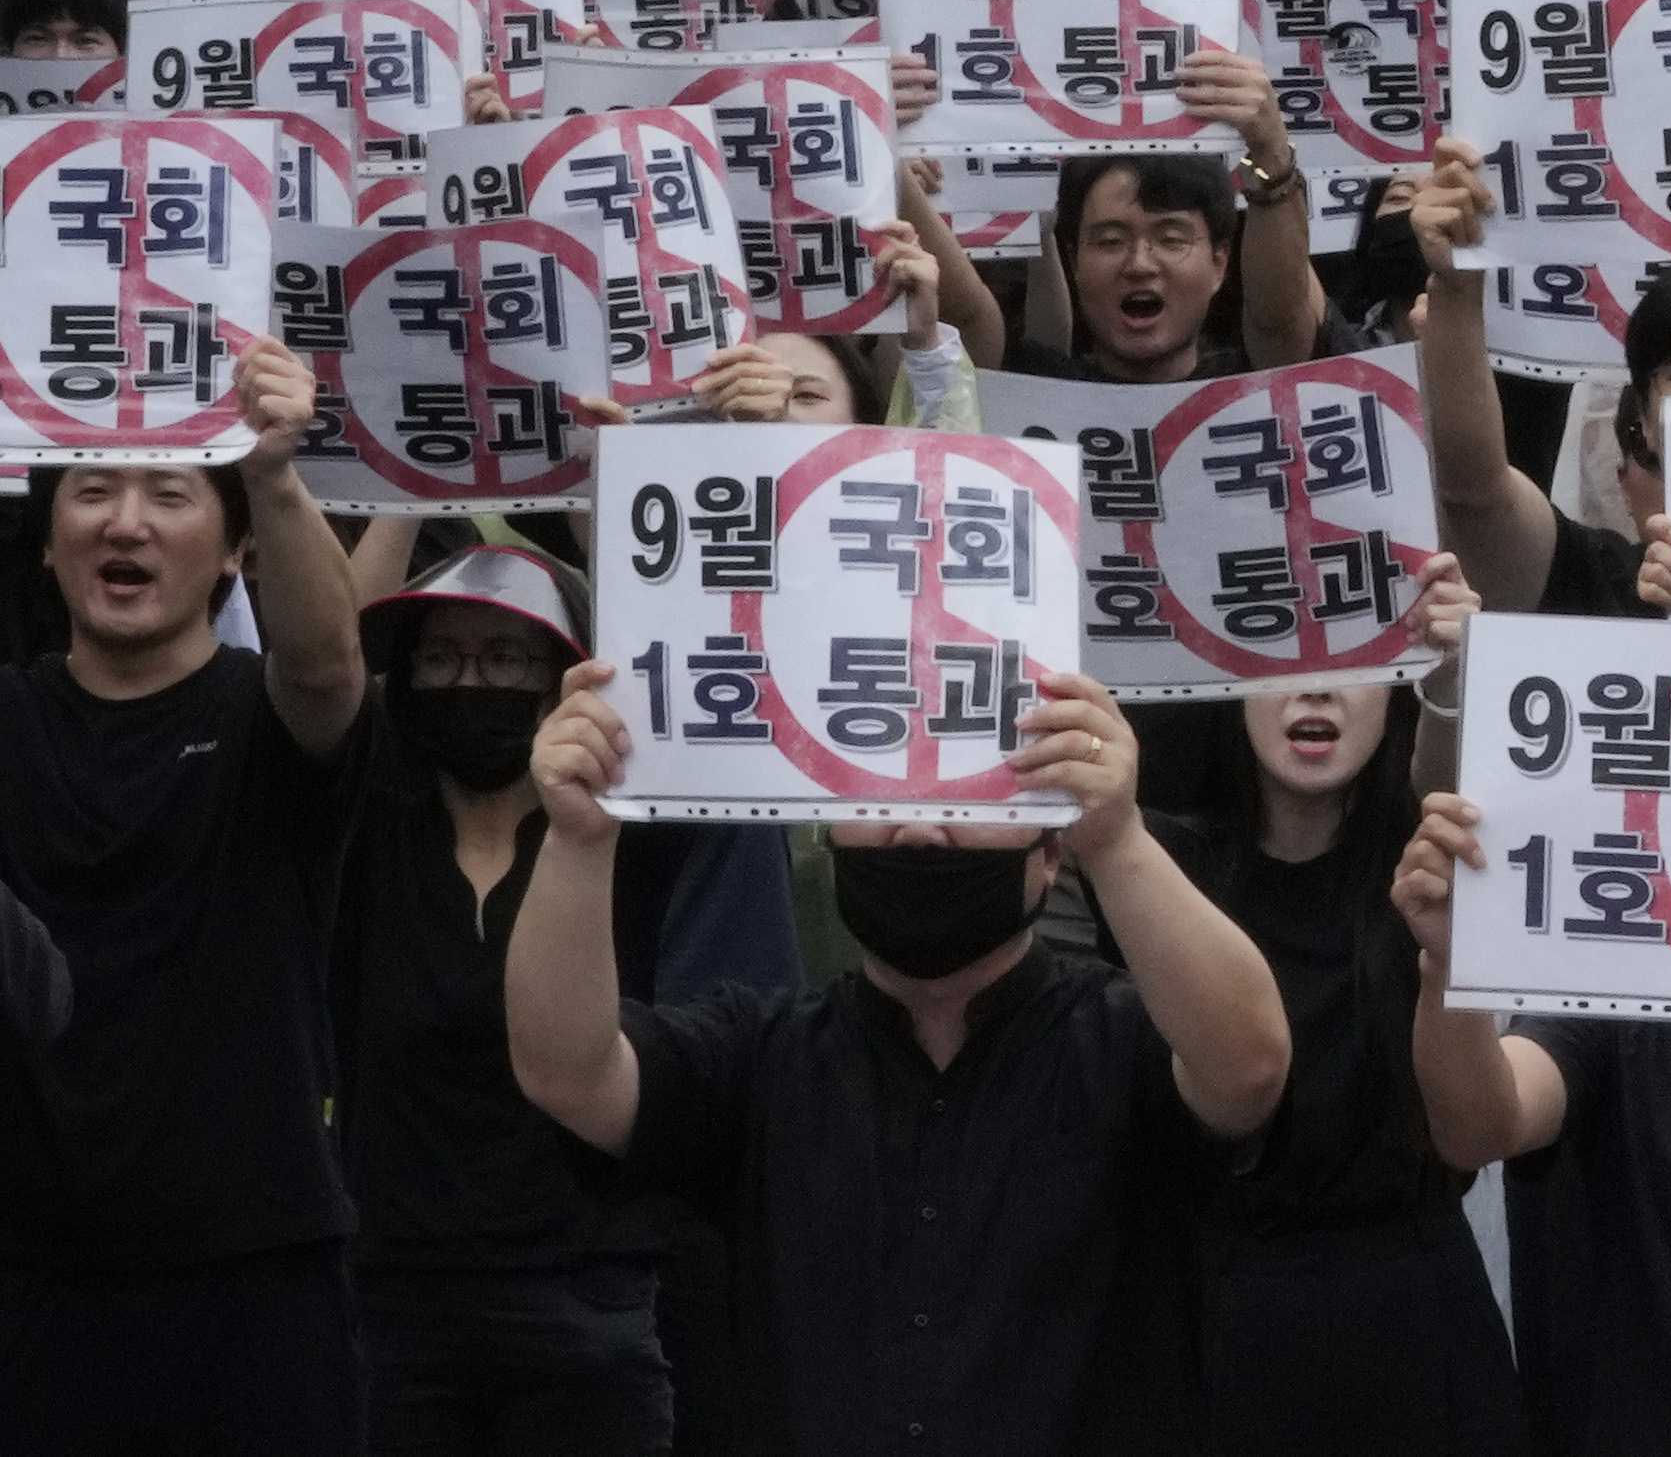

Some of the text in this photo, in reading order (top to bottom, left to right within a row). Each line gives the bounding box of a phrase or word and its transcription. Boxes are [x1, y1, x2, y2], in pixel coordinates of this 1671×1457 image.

[46, 165, 230, 265] 국회
[1484, 135, 1617, 220] 1호
[39, 303, 226, 405] 통과
[389, 253, 564, 353] 국회
[394, 381, 580, 464] 통과
[1200, 392, 1388, 510] 국회
[631, 474, 1034, 598] 9월 국회
[1211, 526, 1401, 638] 통과
[630, 636, 1030, 752] 1호 통과
[1506, 832, 1665, 943] 1호
